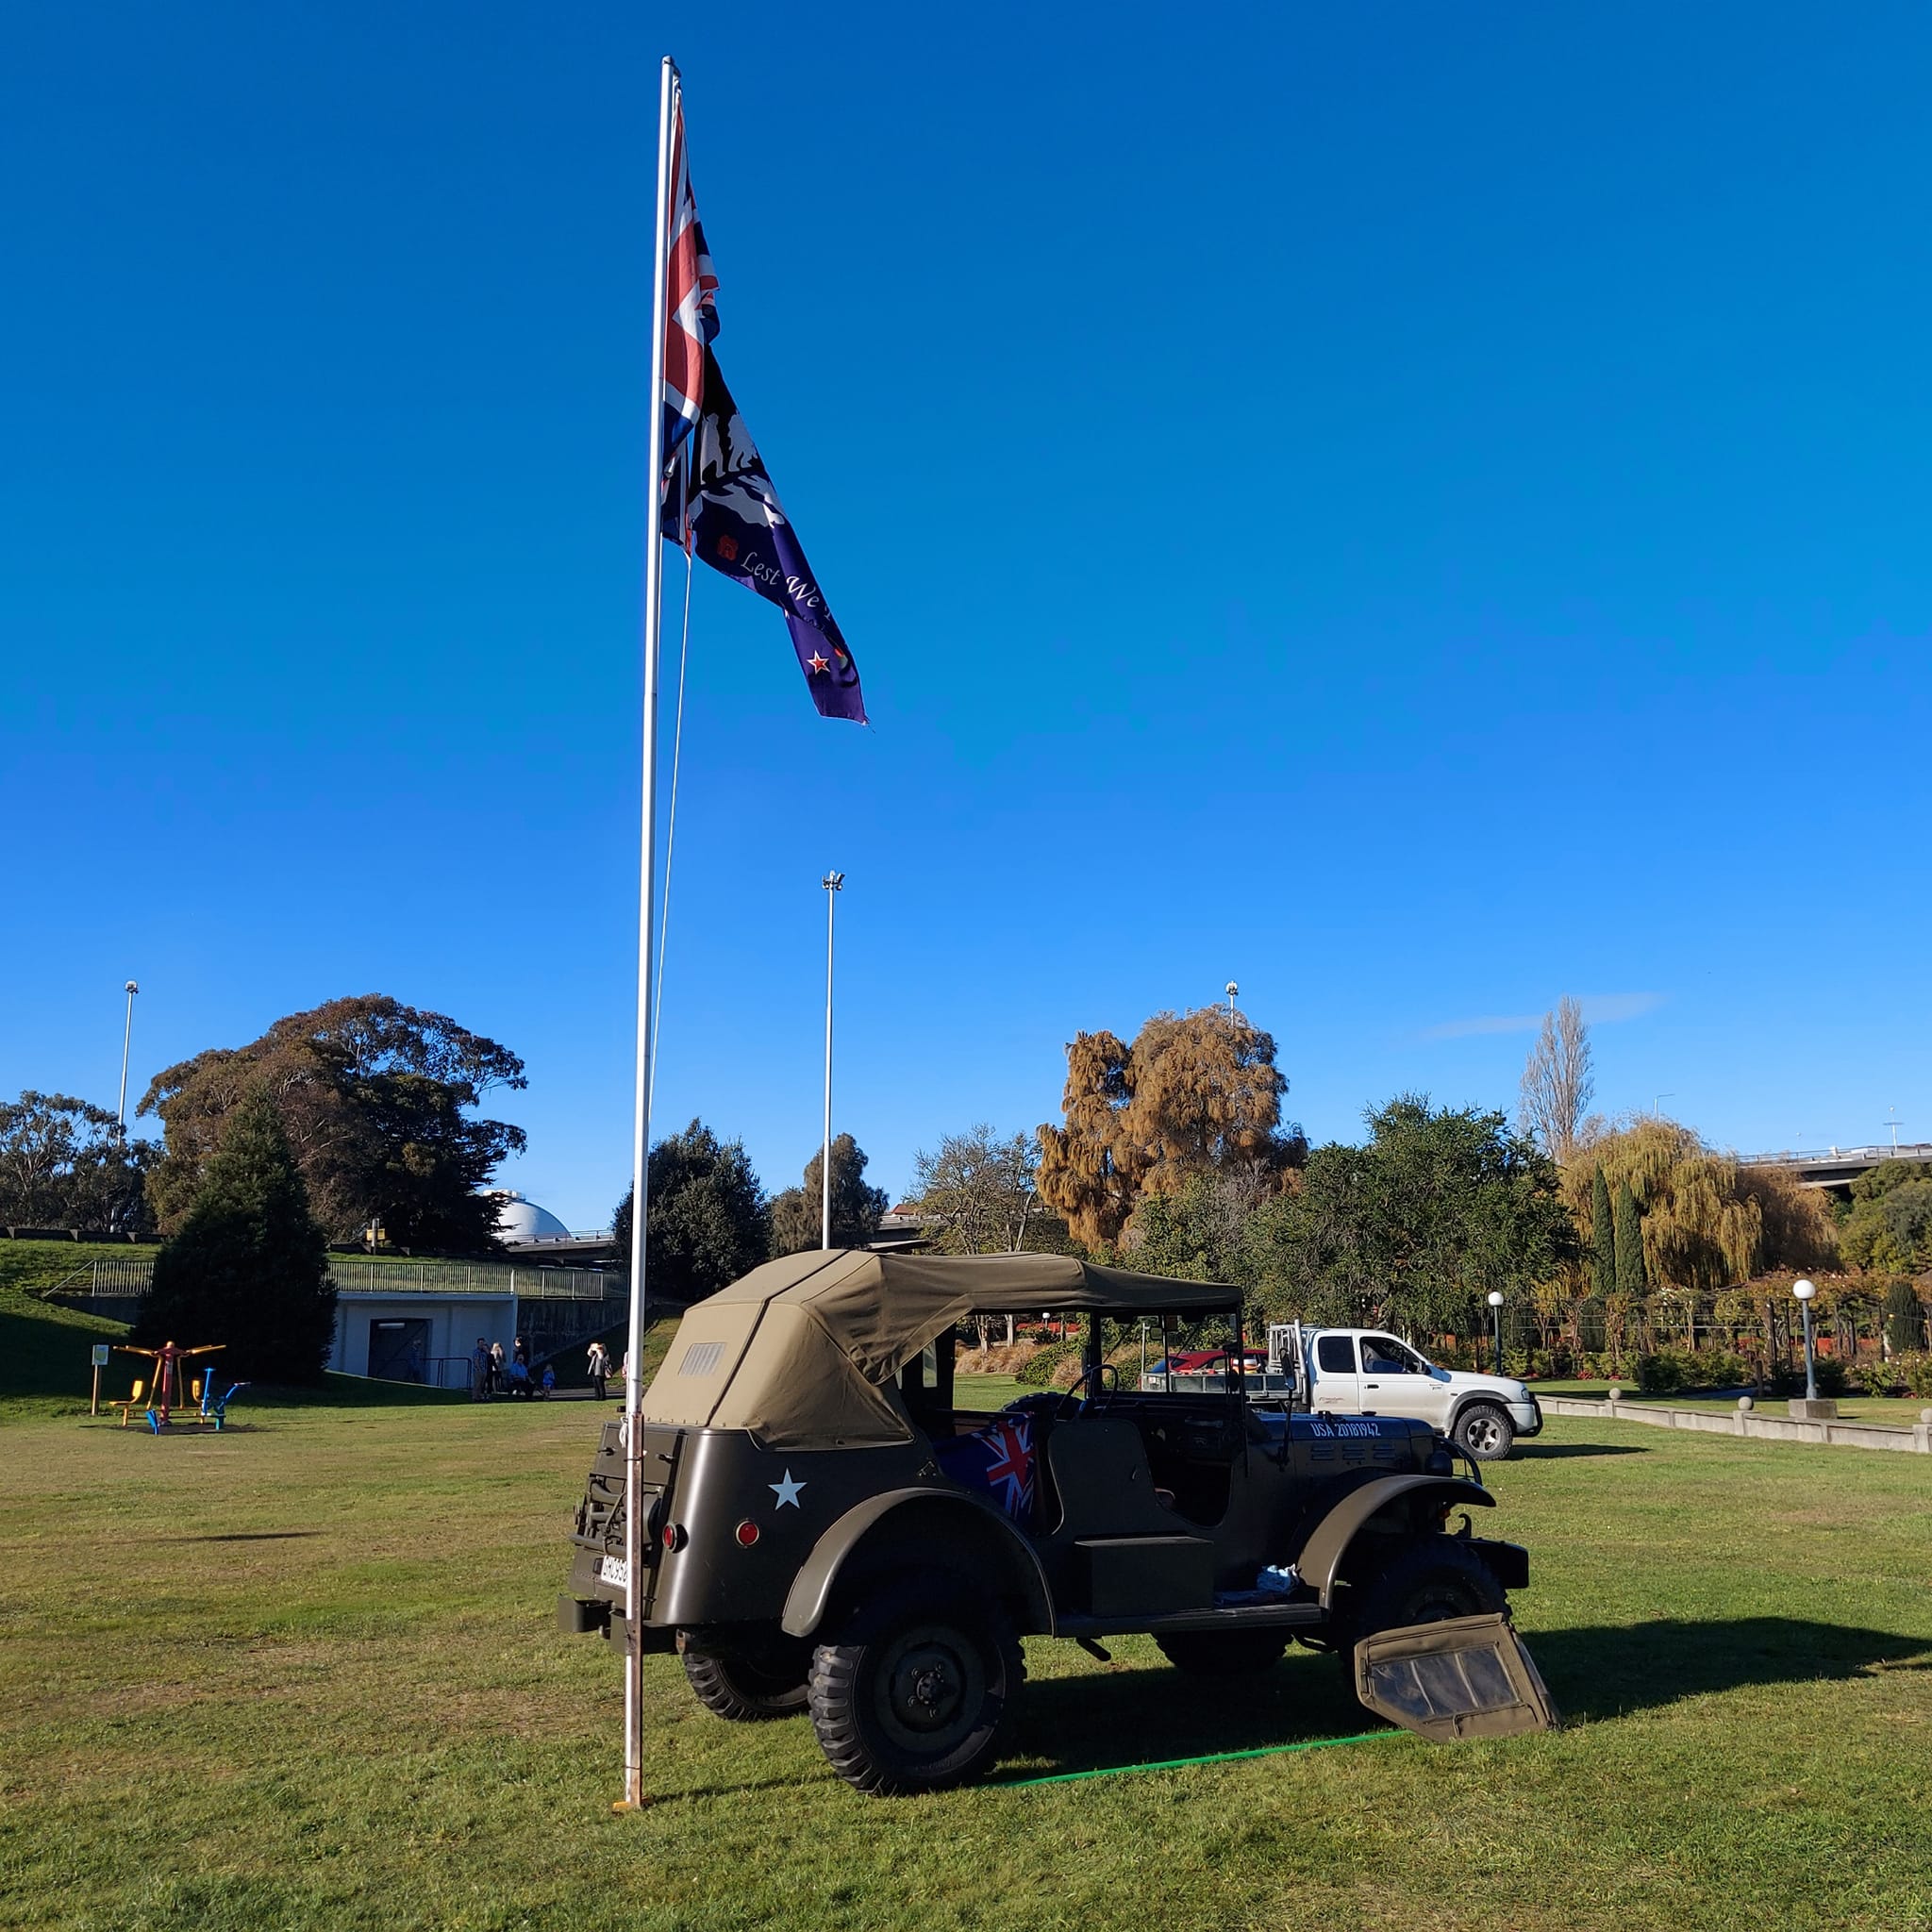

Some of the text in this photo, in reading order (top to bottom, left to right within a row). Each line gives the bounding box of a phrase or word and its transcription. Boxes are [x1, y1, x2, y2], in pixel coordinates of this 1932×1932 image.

[741, 552, 820, 608] Lest We
[1310, 1423, 1381, 1437] USA 20181942
